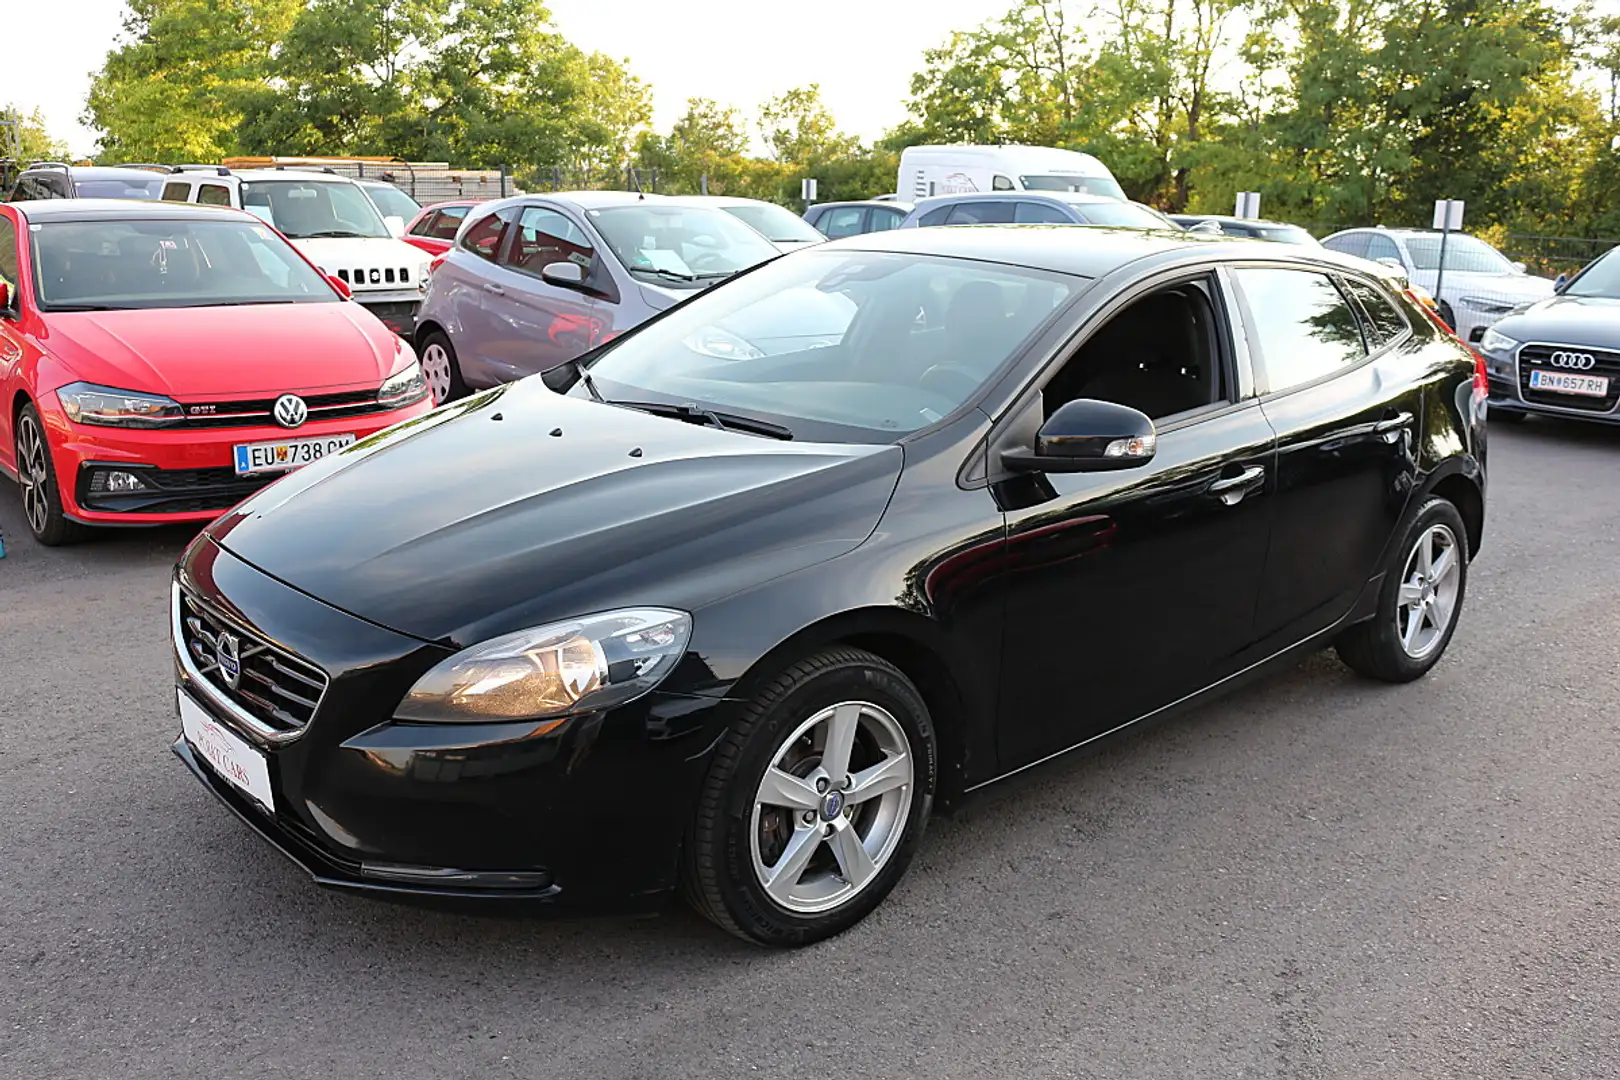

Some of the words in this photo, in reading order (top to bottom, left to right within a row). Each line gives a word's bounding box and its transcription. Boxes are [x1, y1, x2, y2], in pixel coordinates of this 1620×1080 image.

[1540, 375, 1555, 386] BN
[1562, 377, 1585, 389] 657
[1586, 380, 1603, 392] RH
[190, 405, 216, 414] GTI
[252, 447, 276, 467] EU
[289, 442, 323, 463] 738
